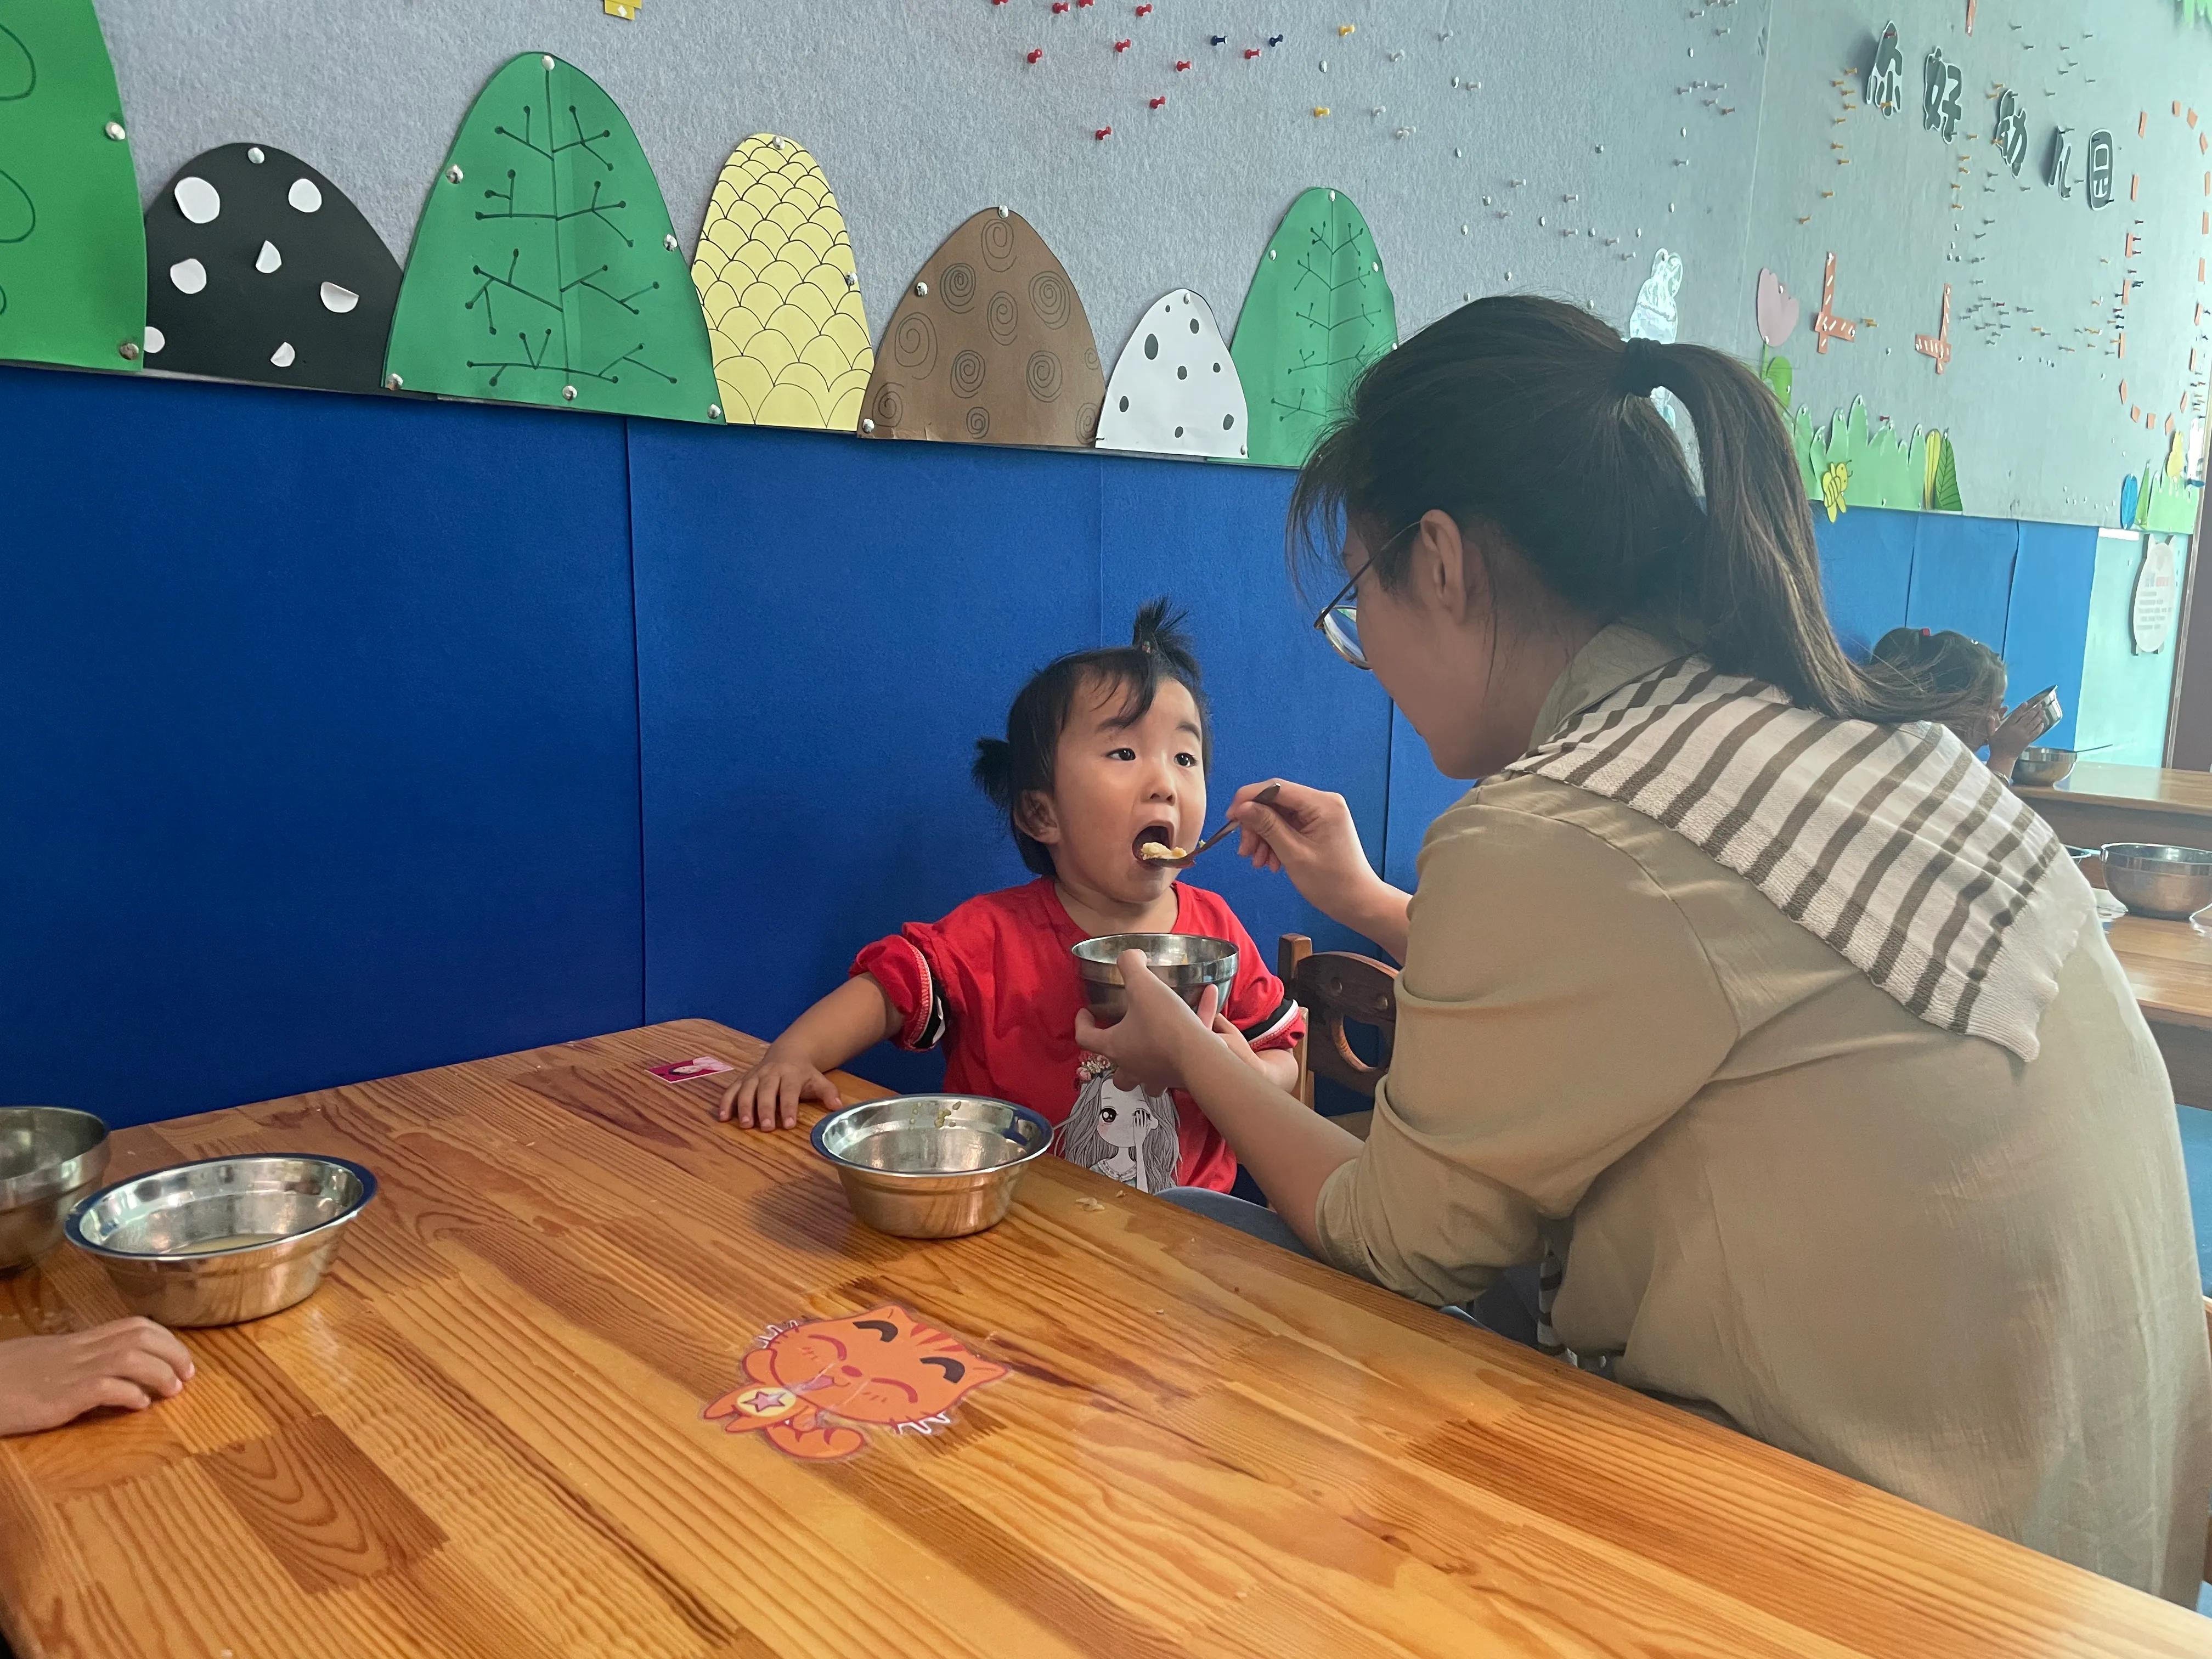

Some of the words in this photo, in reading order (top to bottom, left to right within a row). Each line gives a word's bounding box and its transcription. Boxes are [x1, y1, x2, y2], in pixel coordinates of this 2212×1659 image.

[1866, 20, 2113, 211] 你好幼儿园
